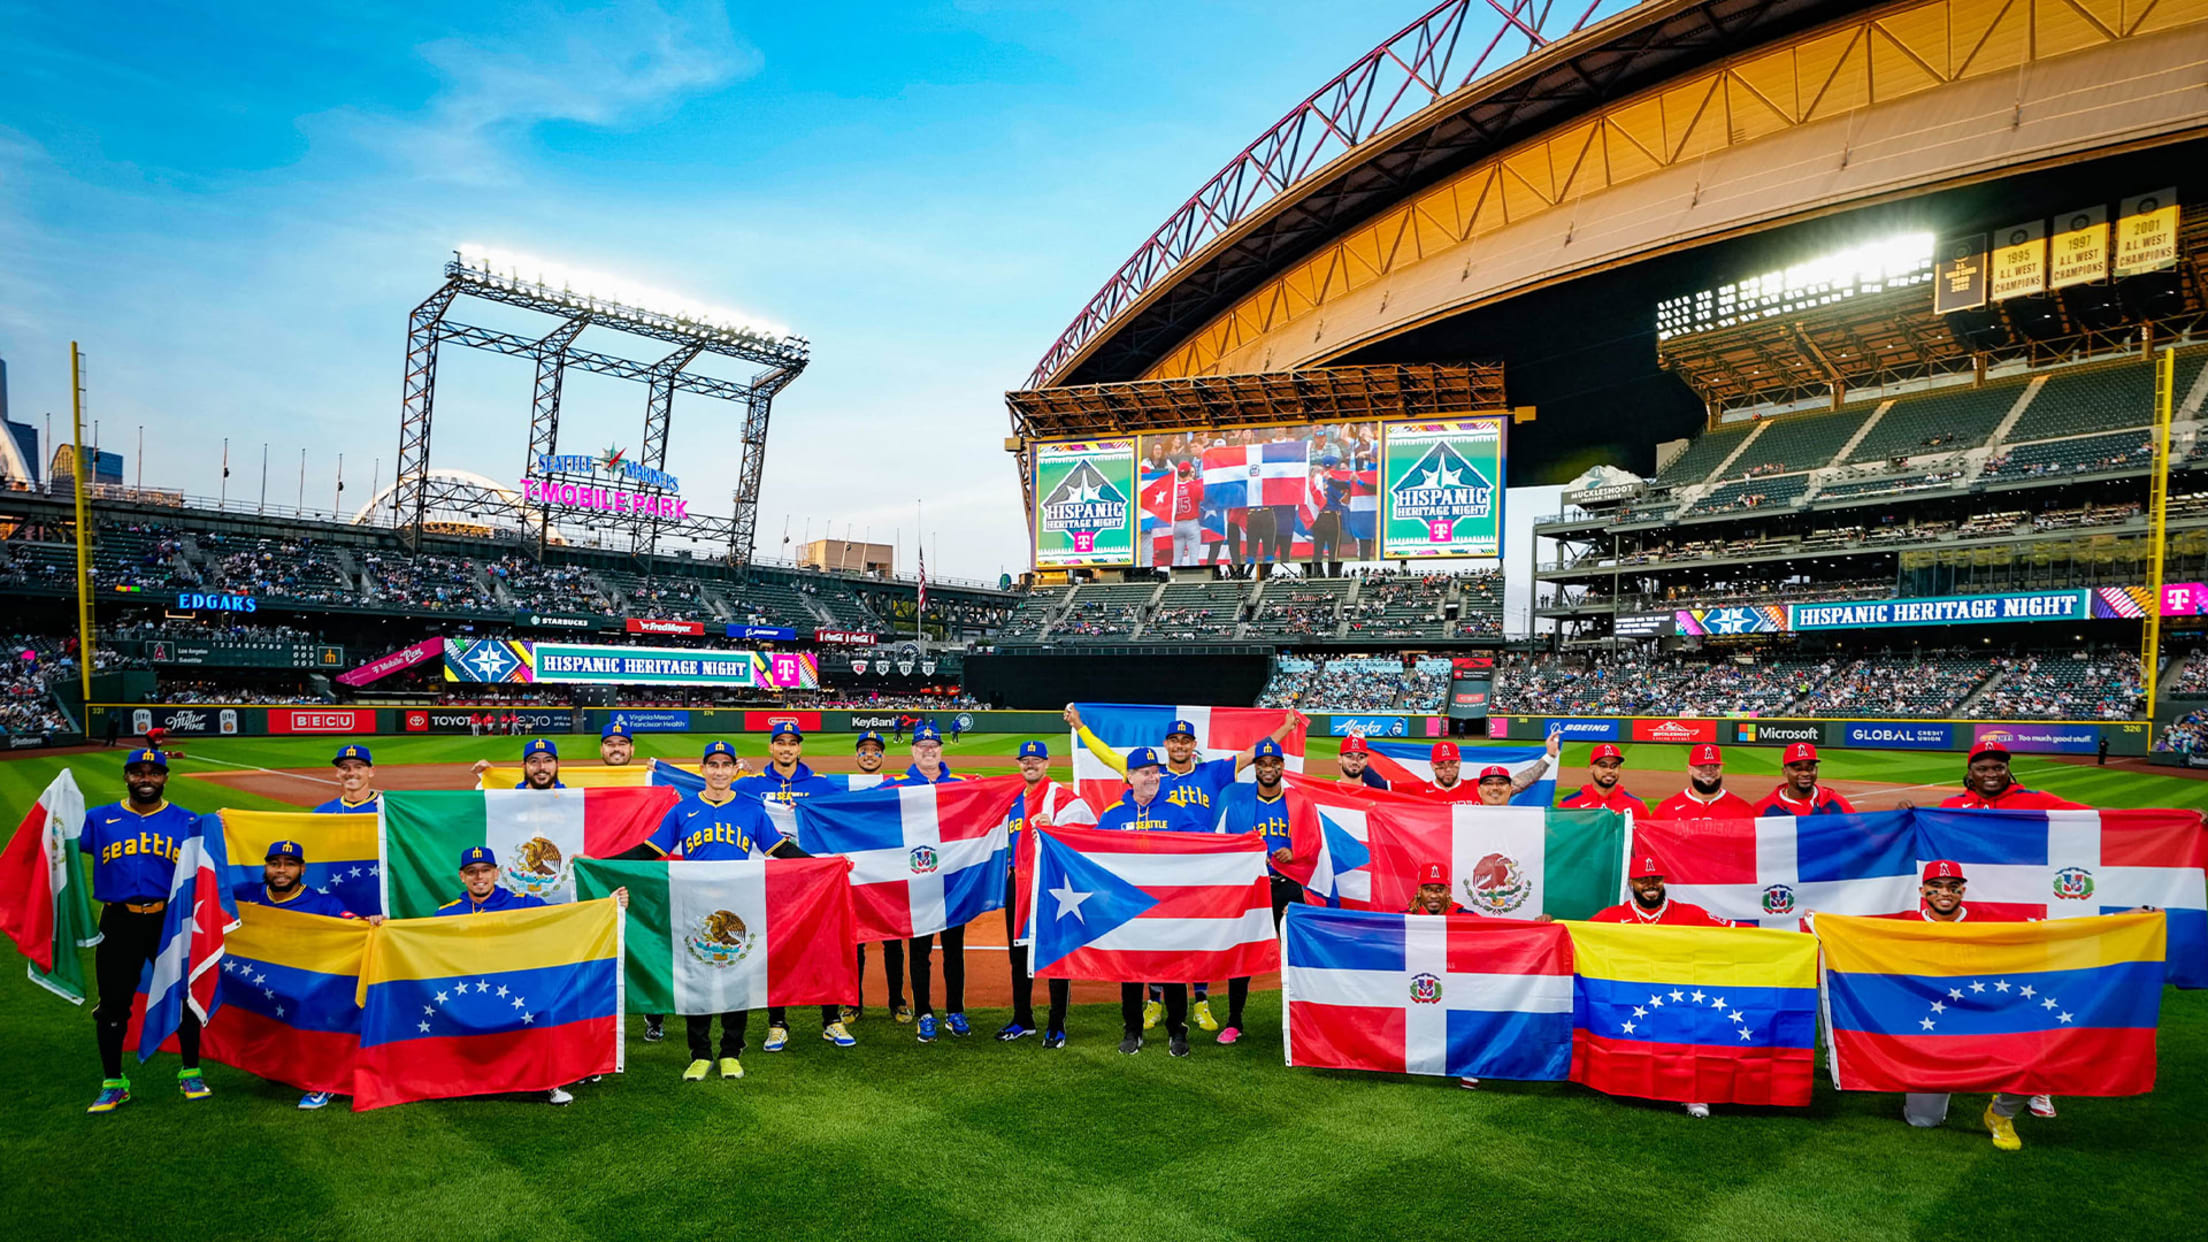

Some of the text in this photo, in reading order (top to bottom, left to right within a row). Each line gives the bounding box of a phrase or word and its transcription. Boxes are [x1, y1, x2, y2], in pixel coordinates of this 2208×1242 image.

[2134, 220, 2160, 235] 2001
[2069, 235, 2091, 250] 1997
[2143, 233, 2167, 248] WEST
[2007, 249, 2031, 265] 1995
[2076, 249, 2099, 263] WEST
[2119, 247, 2172, 267] CHAMPIONS
[2018, 262, 2036, 275] WEST
[2054, 261, 2104, 281] CHAMPIONS
[1994, 276, 2041, 294] CHAMPIONS
[538, 454, 680, 493] SEATTLE MARINERS
[520, 479, 689, 519] T-MOBILE PARK
[1397, 488, 1488, 506] HISPANIC
[1571, 484, 1633, 499] MUCKLESHOOT
[1047, 502, 1124, 519] HISPANIC
[1397, 505, 1488, 517] HERITAGE NIGHT
[1047, 517, 1123, 529] HERITAGE NIGHT
[1800, 595, 2078, 625] HISPANIC HERITAGE NIGHT
[542, 617, 588, 627] STARBUCKS
[543, 655, 747, 677] HISPANIC HERITAGE NIGHT
[297, 715, 350, 727] BECU
[432, 716, 473, 726] TOYOT
[1334, 717, 1382, 735] Alaska
[1564, 724, 1610, 732] BOEING
[1759, 727, 1819, 740] Microsoft
[1853, 730, 1914, 741] GLOBAL
[2123, 725, 2141, 733] 326
[2053, 735, 2072, 744] good
[1170, 786, 1210, 808] attle
[1135, 820, 1168, 829] SEATTLE
[686, 821, 750, 854] seattle
